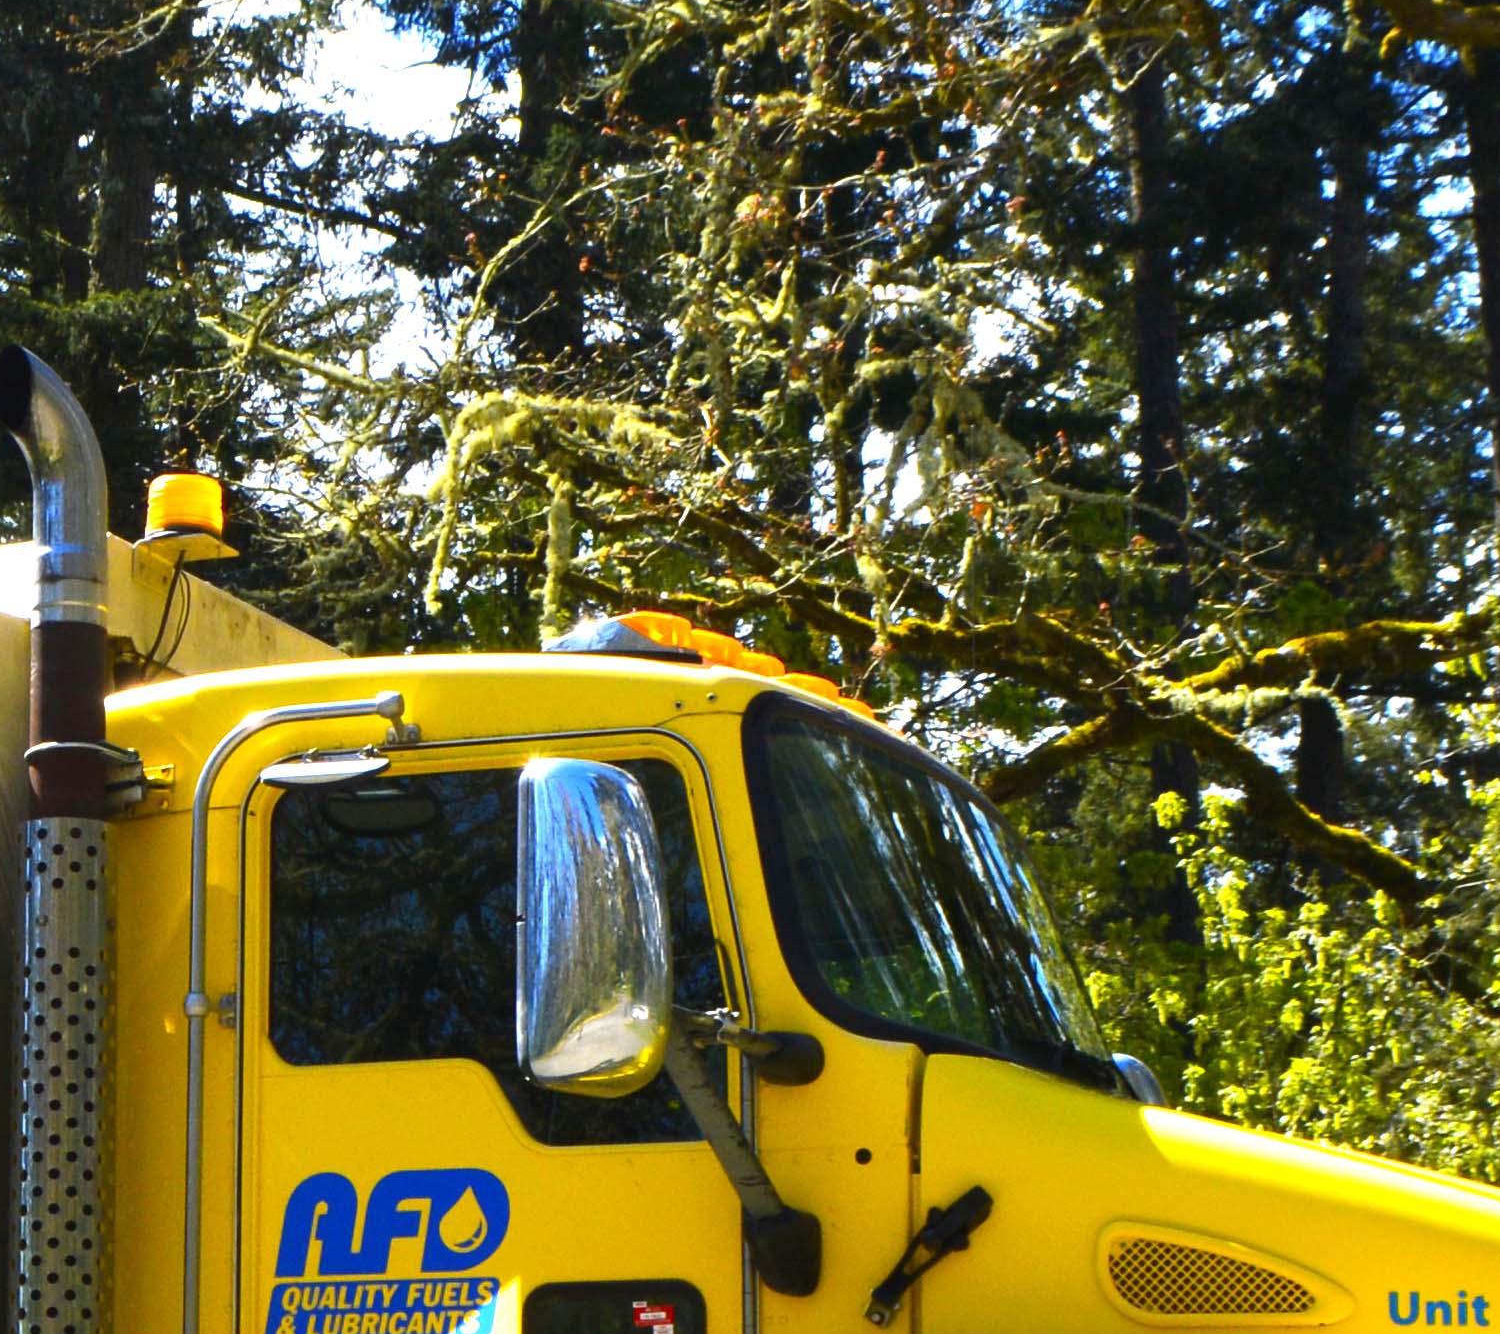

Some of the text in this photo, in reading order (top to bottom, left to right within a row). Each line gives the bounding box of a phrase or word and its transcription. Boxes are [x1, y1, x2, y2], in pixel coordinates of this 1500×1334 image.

[275, 1168, 510, 1277] AFD
[282, 1281, 493, 1311] QUALITY FUELS
[1388, 1291, 1489, 1326] Unit
